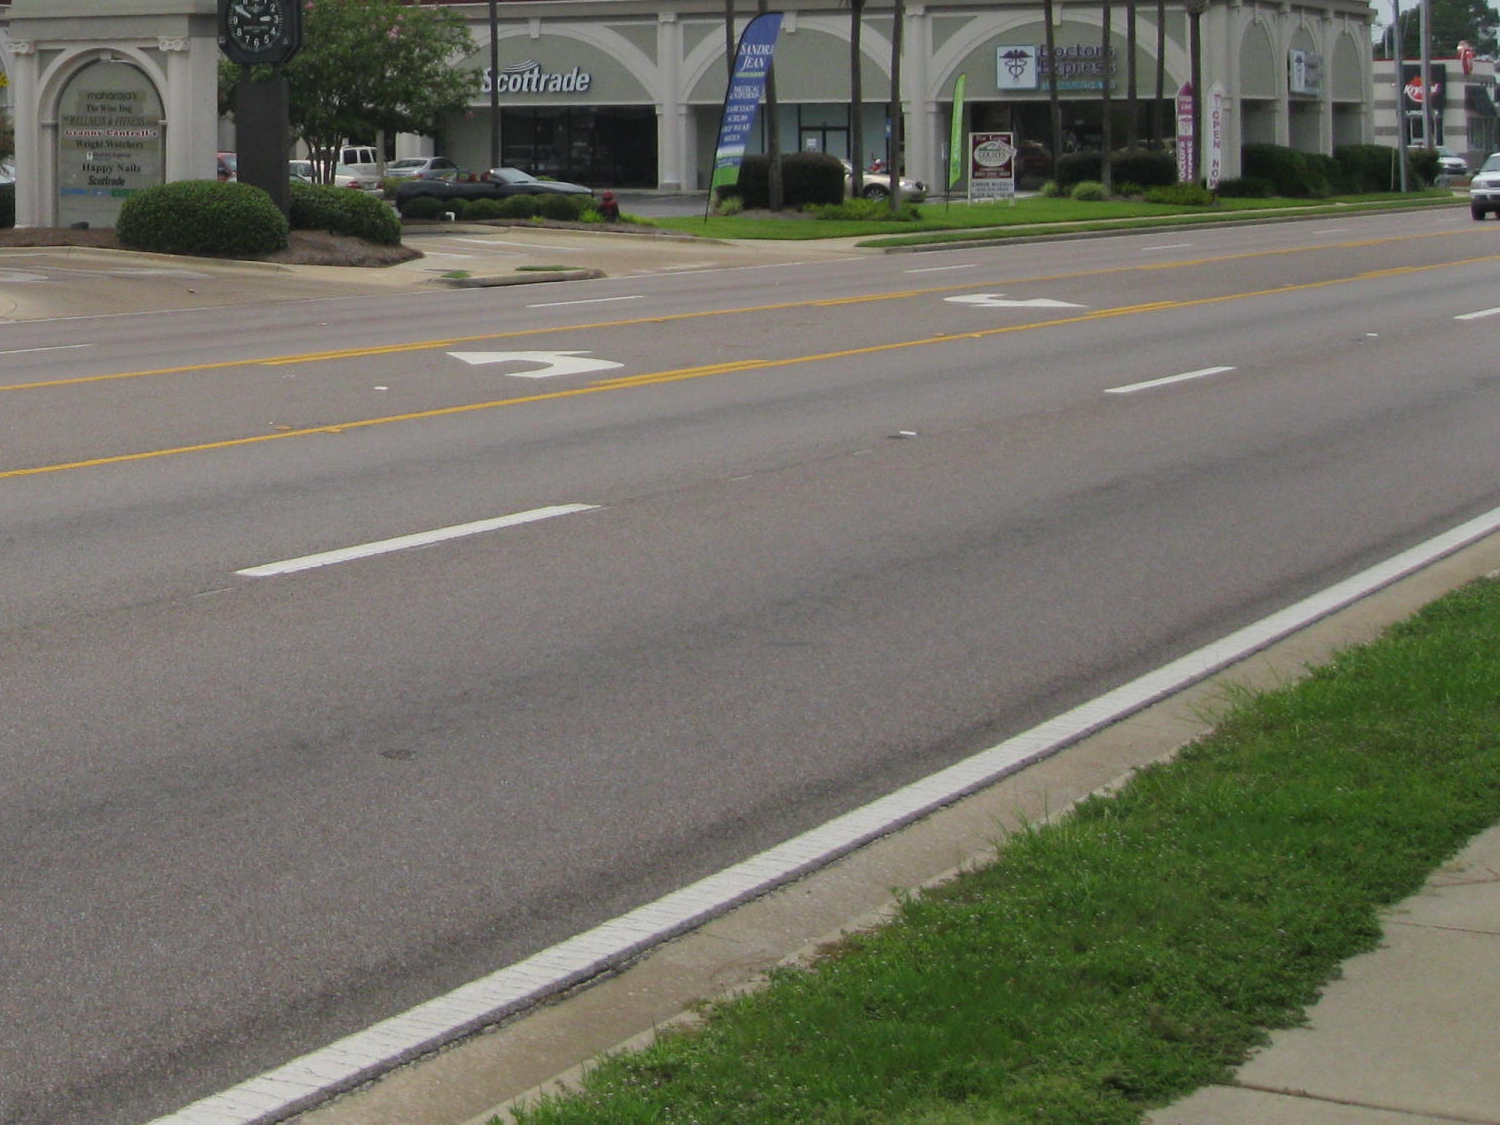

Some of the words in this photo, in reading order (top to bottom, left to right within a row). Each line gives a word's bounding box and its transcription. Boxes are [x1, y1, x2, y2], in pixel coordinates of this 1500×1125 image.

[741, 56, 766, 71] JEAN
[481, 66, 590, 92] Scottrade
[64, 130, 101, 138] Granny
[106, 129, 157, 137] Cantrell's
[76, 139, 104, 149] Weight
[106, 139, 144, 148] Watchers
[82, 163, 113, 174] Happy
[117, 163, 141, 172] Nails
